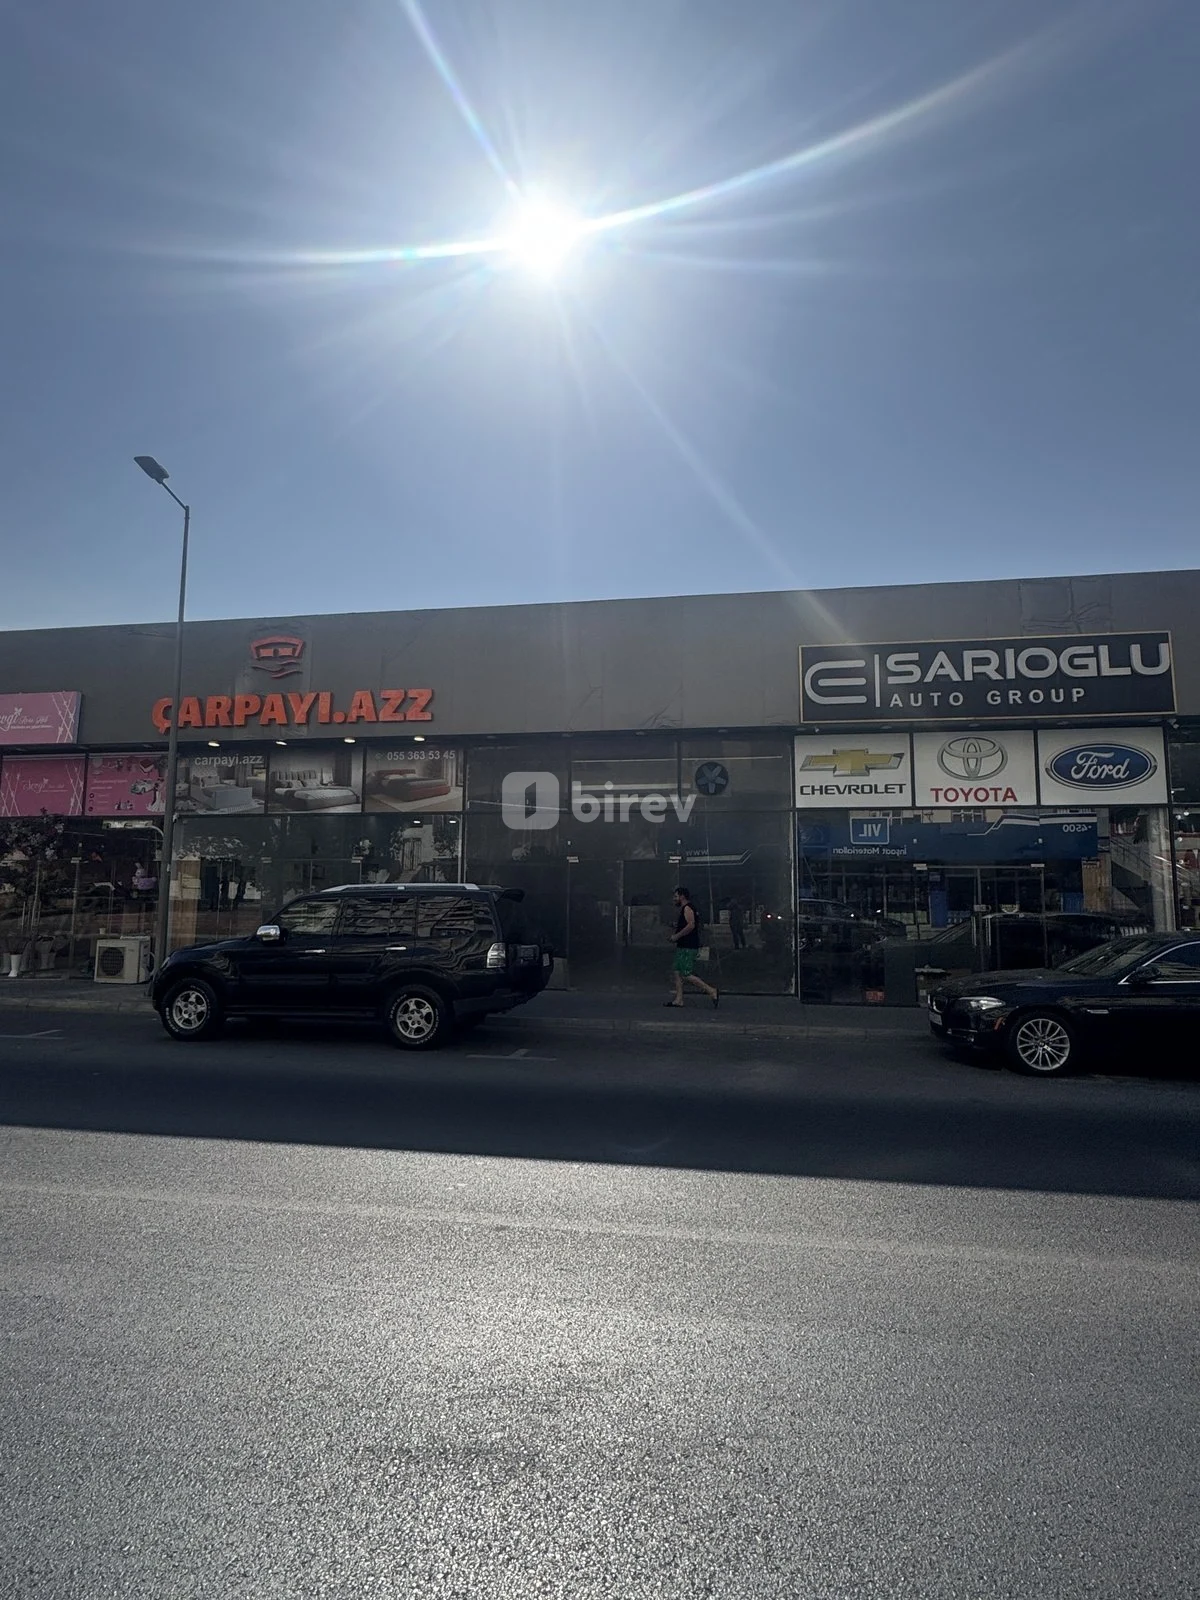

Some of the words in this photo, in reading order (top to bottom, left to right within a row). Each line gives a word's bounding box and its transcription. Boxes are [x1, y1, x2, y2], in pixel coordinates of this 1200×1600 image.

[886, 642, 1171, 685] SARIOGLU
[889, 691, 964, 708] AUTO
[986, 687, 1086, 706] GROUP
[151, 688, 434, 735] ÇARPAYI.AZZ
[193, 754, 263, 769] carpayi.azz
[387, 751, 405, 761] 055
[407, 751, 426, 760] 363
[428, 750, 441, 760] 53
[442, 750, 456, 760] 45
[1070, 750, 1130, 781] Ford
[799, 782, 907, 796] CHEVROLET
[930, 787, 1018, 803] TOYOTA
